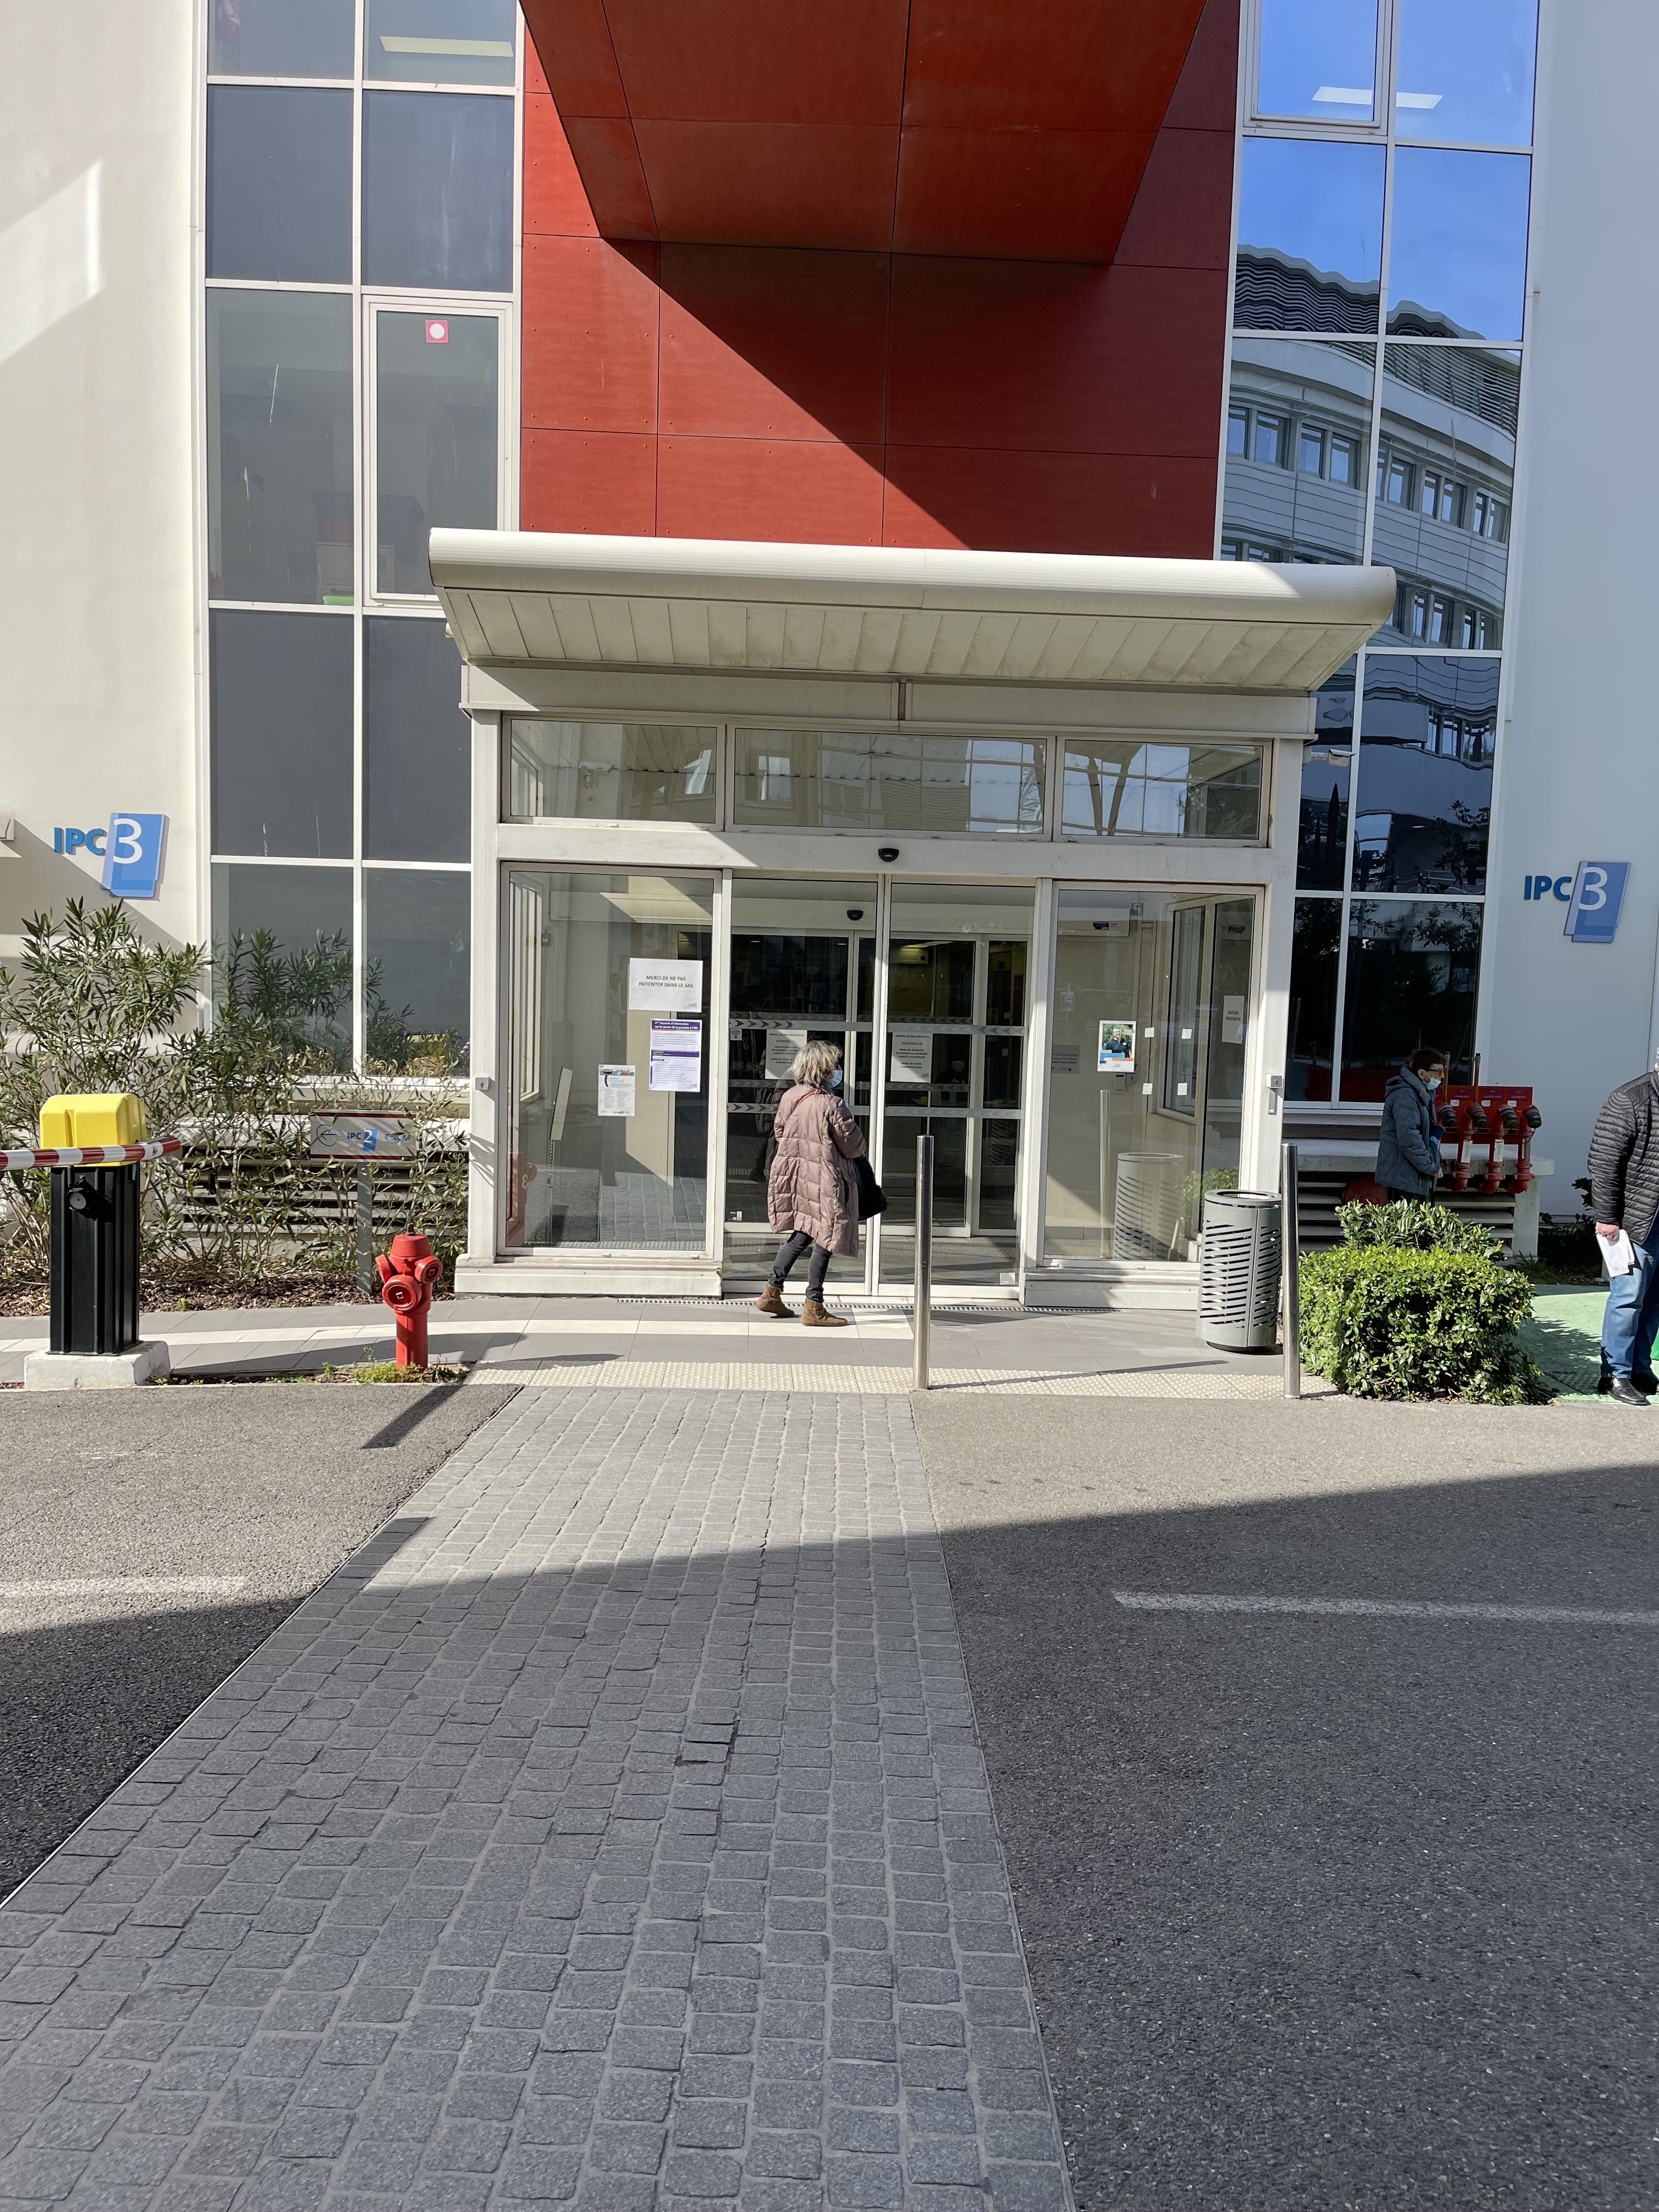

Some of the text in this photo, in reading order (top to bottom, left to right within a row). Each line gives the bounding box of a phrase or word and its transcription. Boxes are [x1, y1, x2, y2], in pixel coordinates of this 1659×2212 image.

[53, 818, 142, 864] IPC 3
[1524, 866, 1608, 911] IPC 3
[363, 1130, 373, 1143] 2
